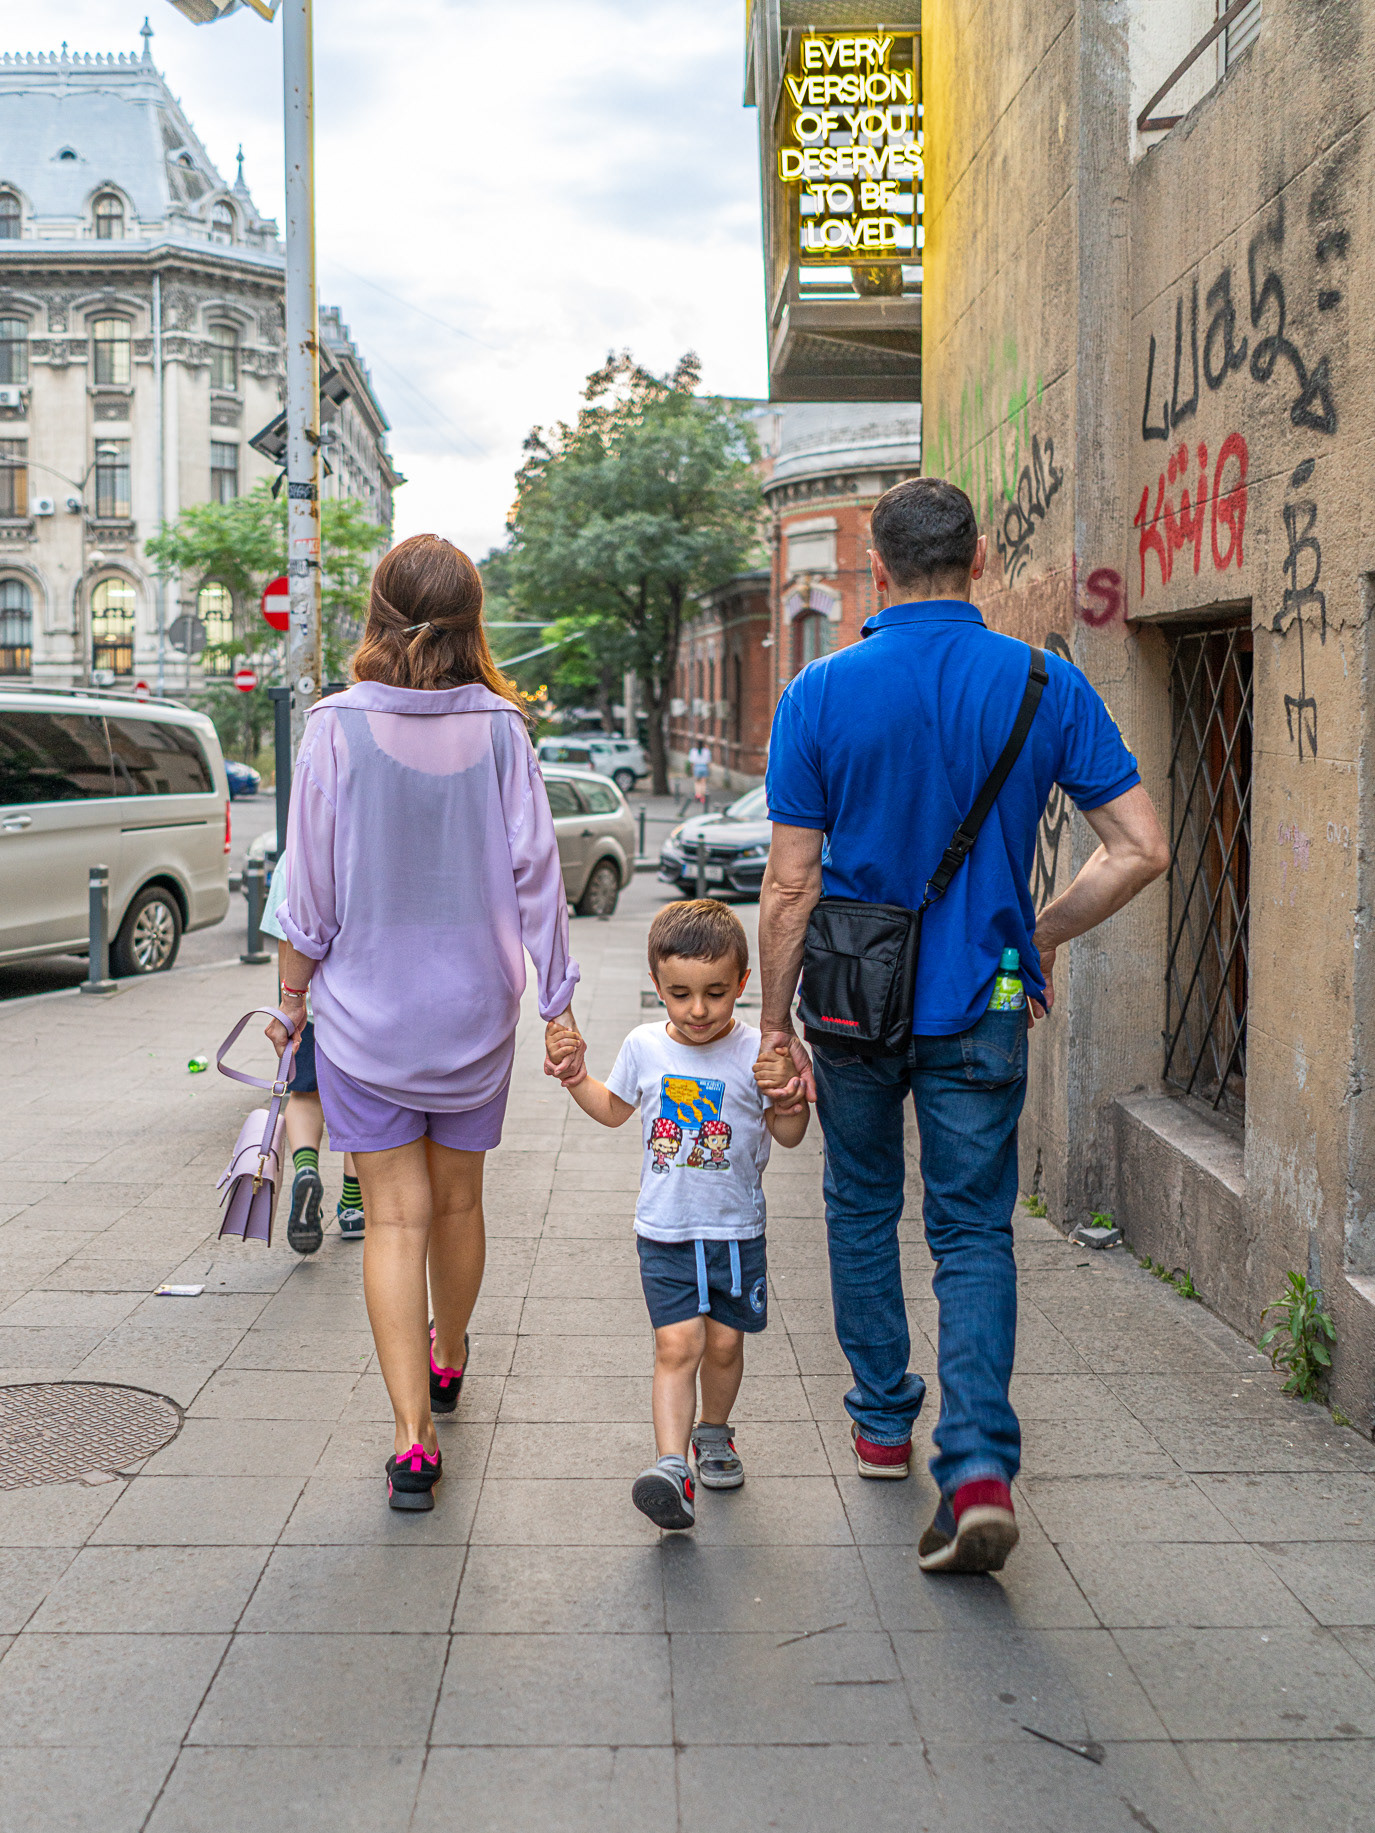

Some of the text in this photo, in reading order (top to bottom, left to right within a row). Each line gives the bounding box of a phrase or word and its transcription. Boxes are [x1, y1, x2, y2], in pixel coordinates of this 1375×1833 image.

[804, 36, 891, 69] EVERY
[788, 72, 912, 104] VERSION
[795, 108, 907, 141] OF YOU
[781, 143, 924, 178] DESERVES
[811, 181, 896, 212] TO BE
[807, 216, 901, 249] LOVED
[821, 1016, 859, 1027] MAMMUT
